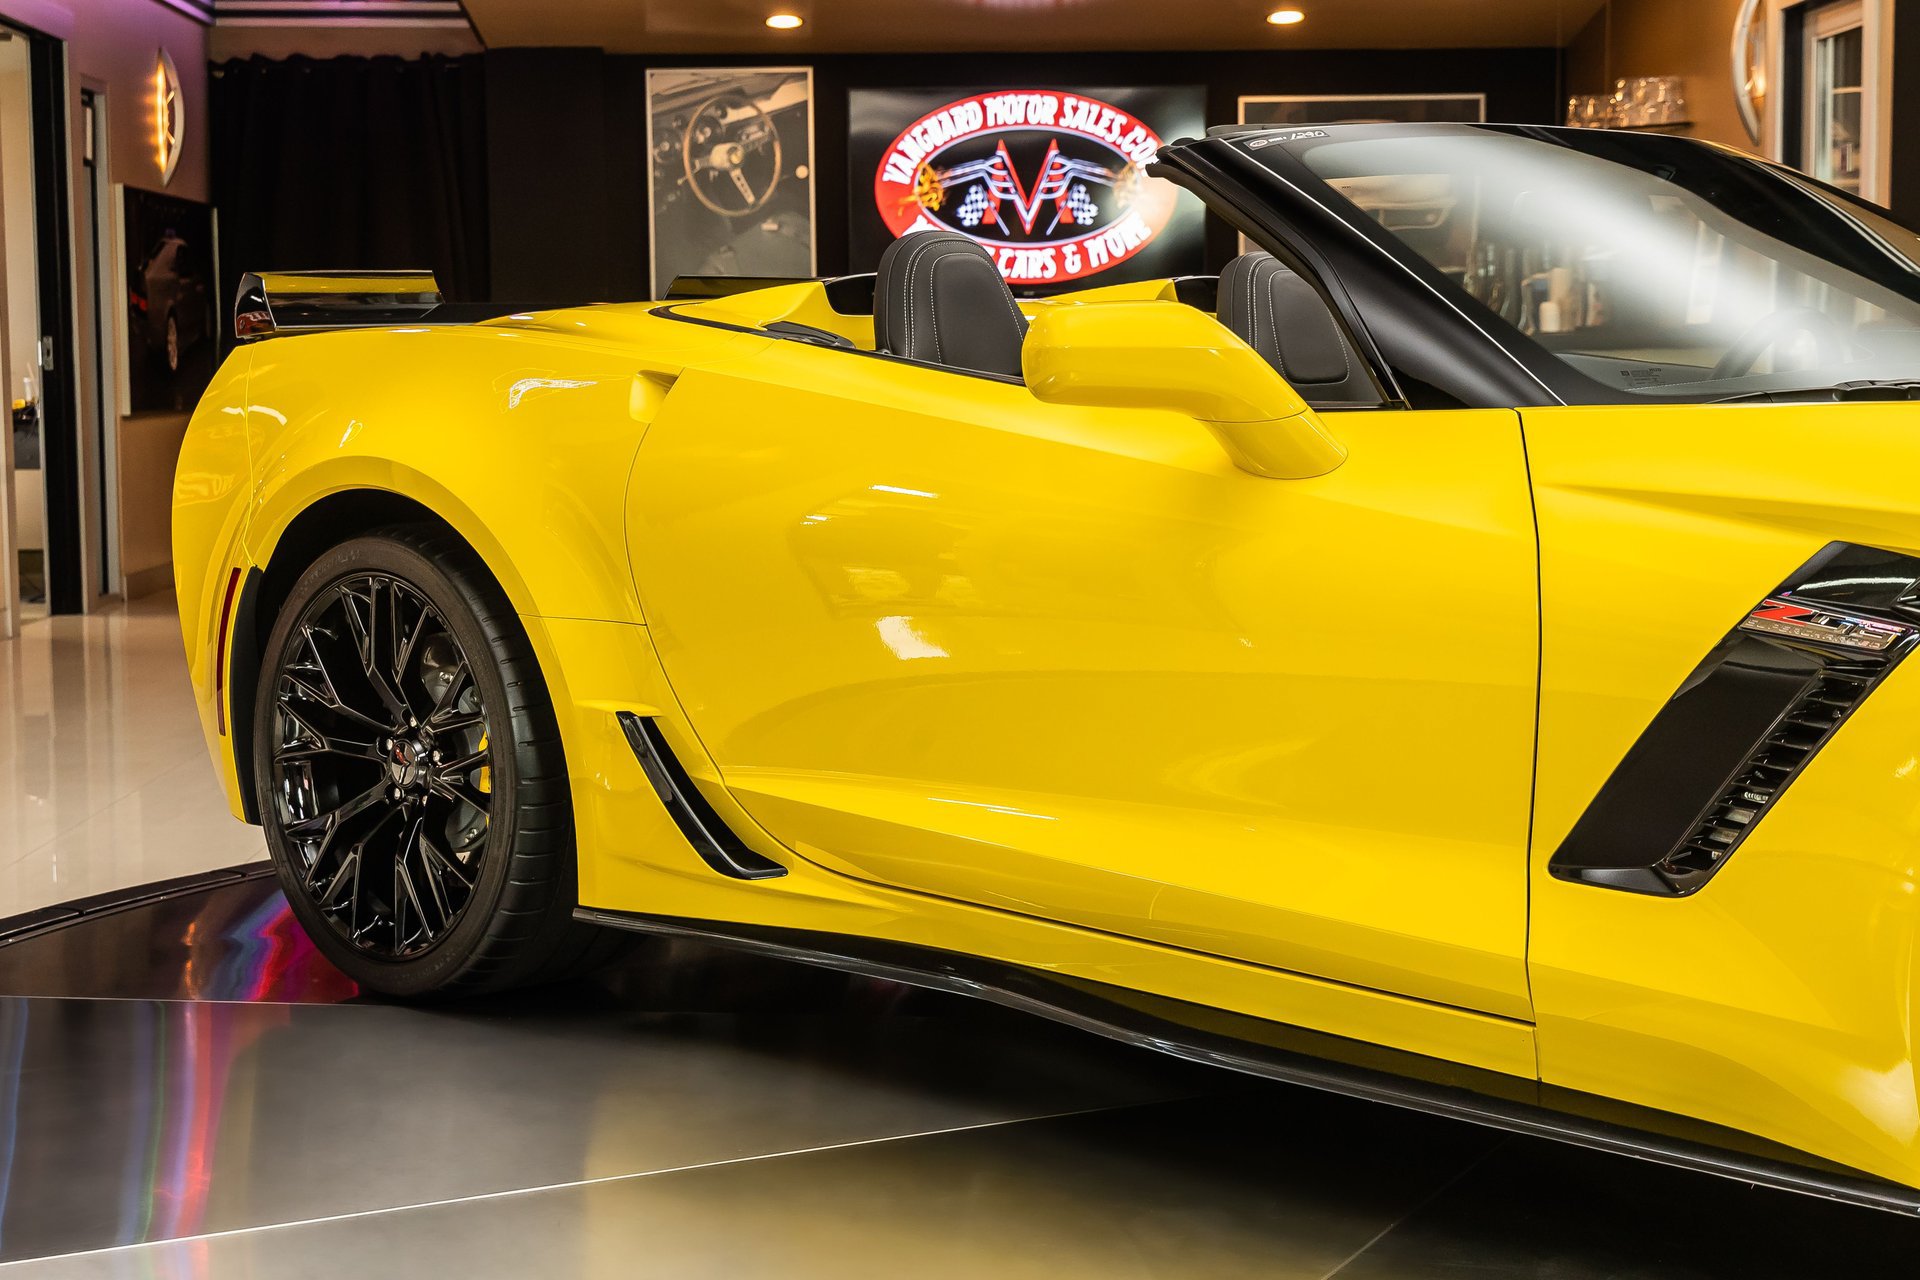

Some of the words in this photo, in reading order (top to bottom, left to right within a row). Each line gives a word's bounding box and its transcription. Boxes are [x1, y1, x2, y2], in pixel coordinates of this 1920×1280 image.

[882, 100, 983, 185] VANGUARD
[983, 94, 1058, 127] MOTOR
[997, 247, 1057, 279] CARS
[1062, 244, 1082, 274] &
[1083, 211, 1152, 269] MORE
[1751, 598, 1905, 640] Z06
